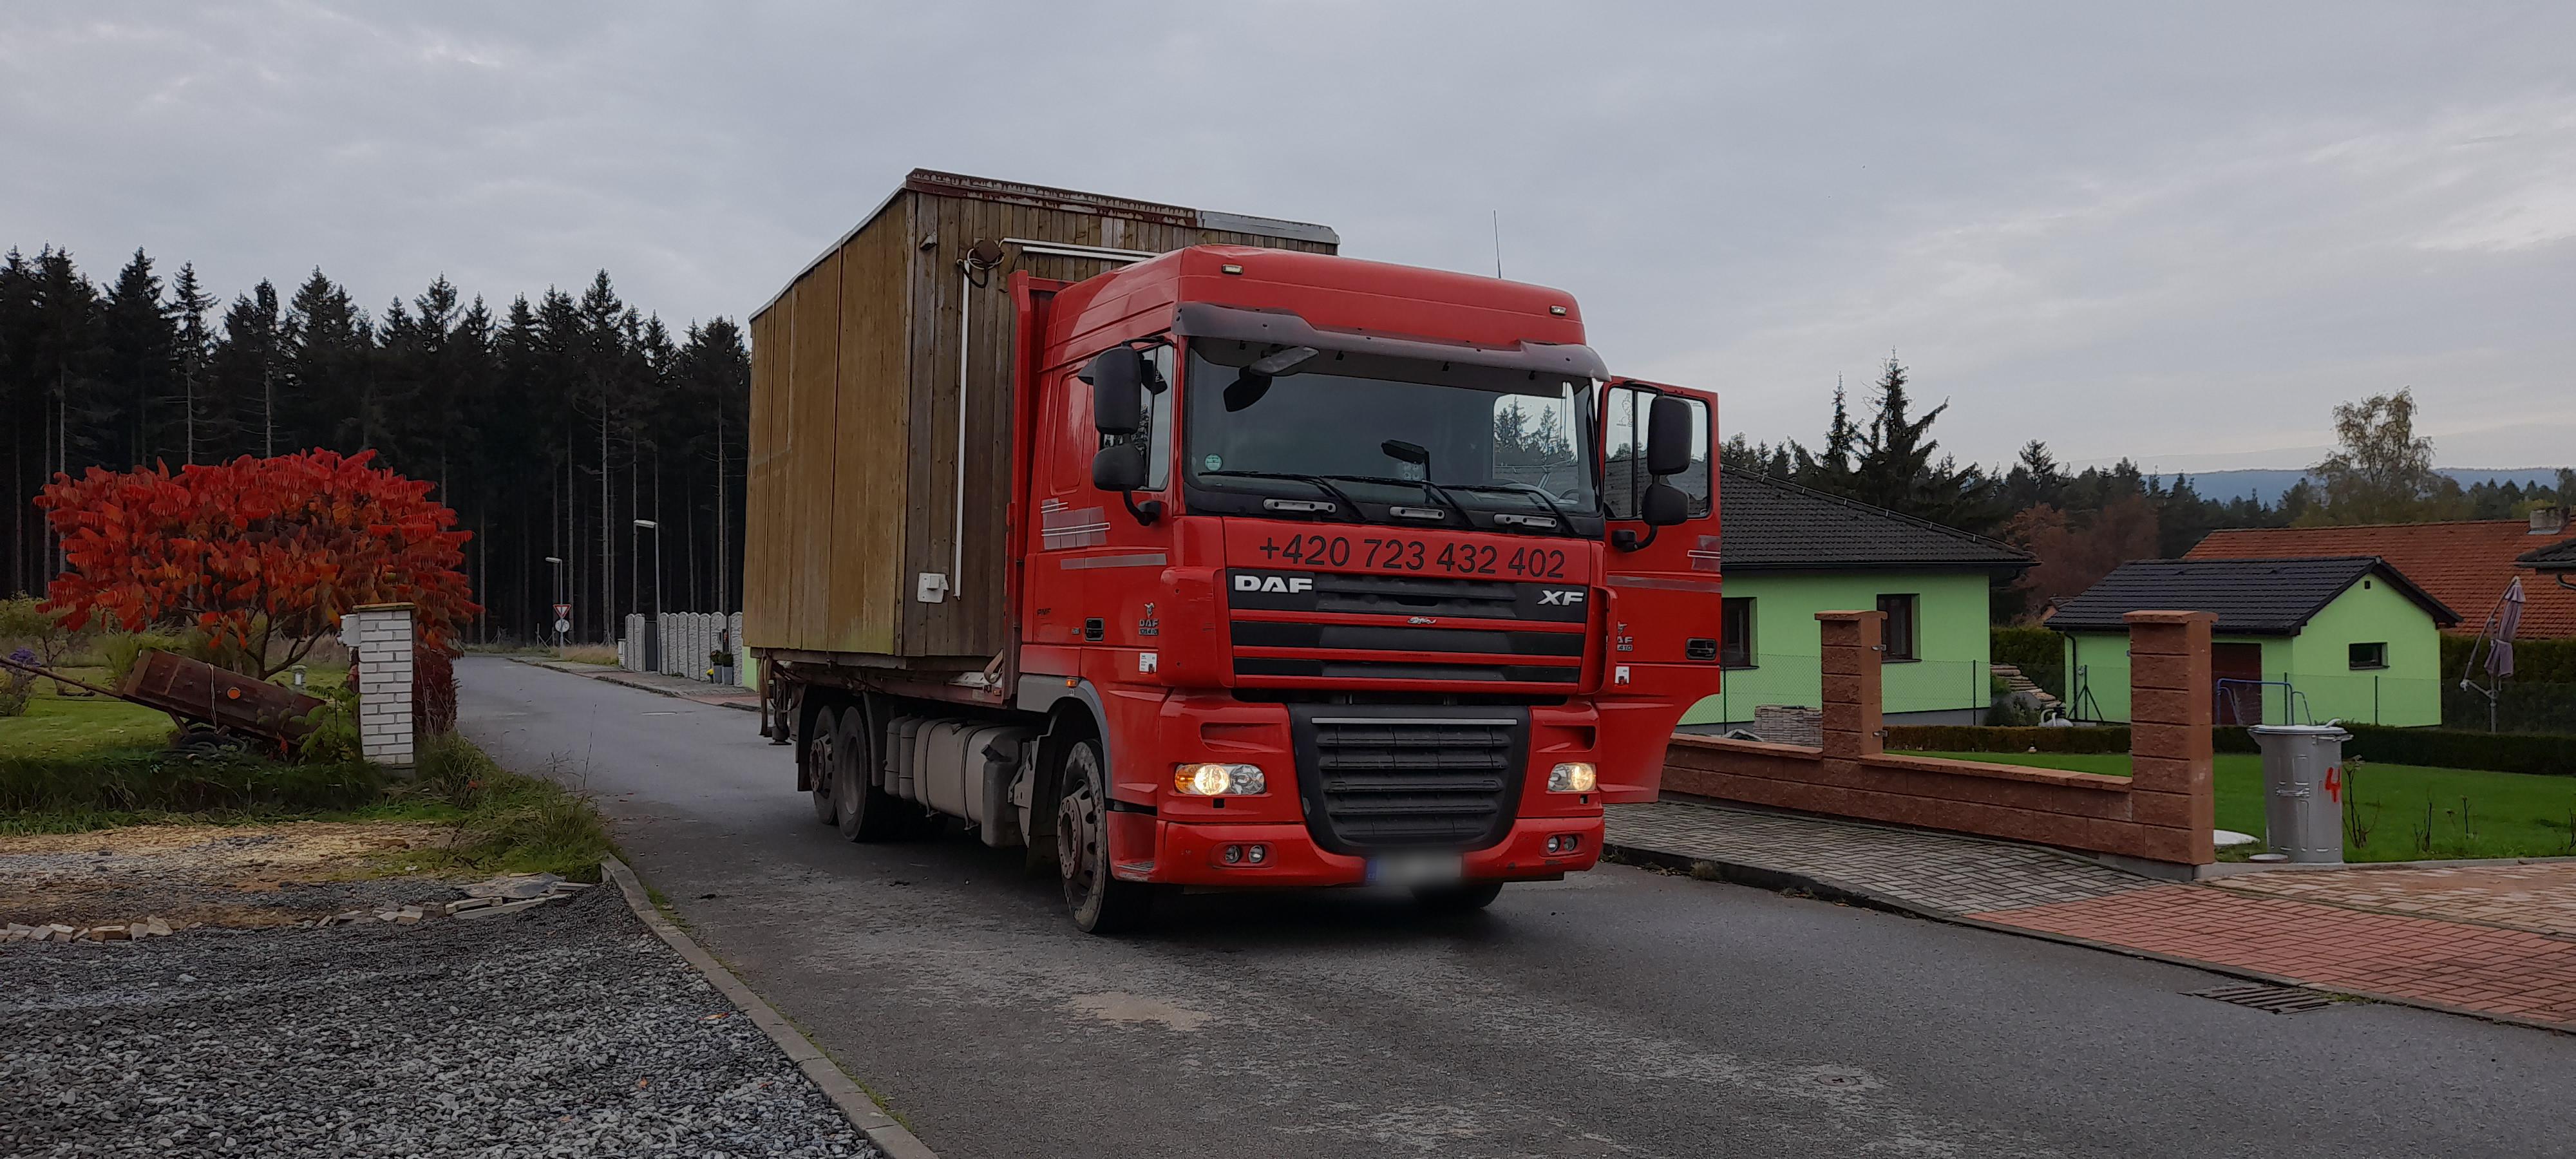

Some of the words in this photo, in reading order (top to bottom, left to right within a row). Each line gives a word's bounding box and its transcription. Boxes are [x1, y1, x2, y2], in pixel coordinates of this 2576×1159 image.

[1259, 534, 1350, 567] +420
[1363, 538, 1426, 570] 723
[1436, 543, 1498, 574] 432
[1508, 547, 1565, 578] 402
[1234, 575, 1313, 594] DAF
[1537, 589, 1585, 606] XF
[1139, 619, 1159, 627] DAF
[2324, 766, 2341, 803] 4
